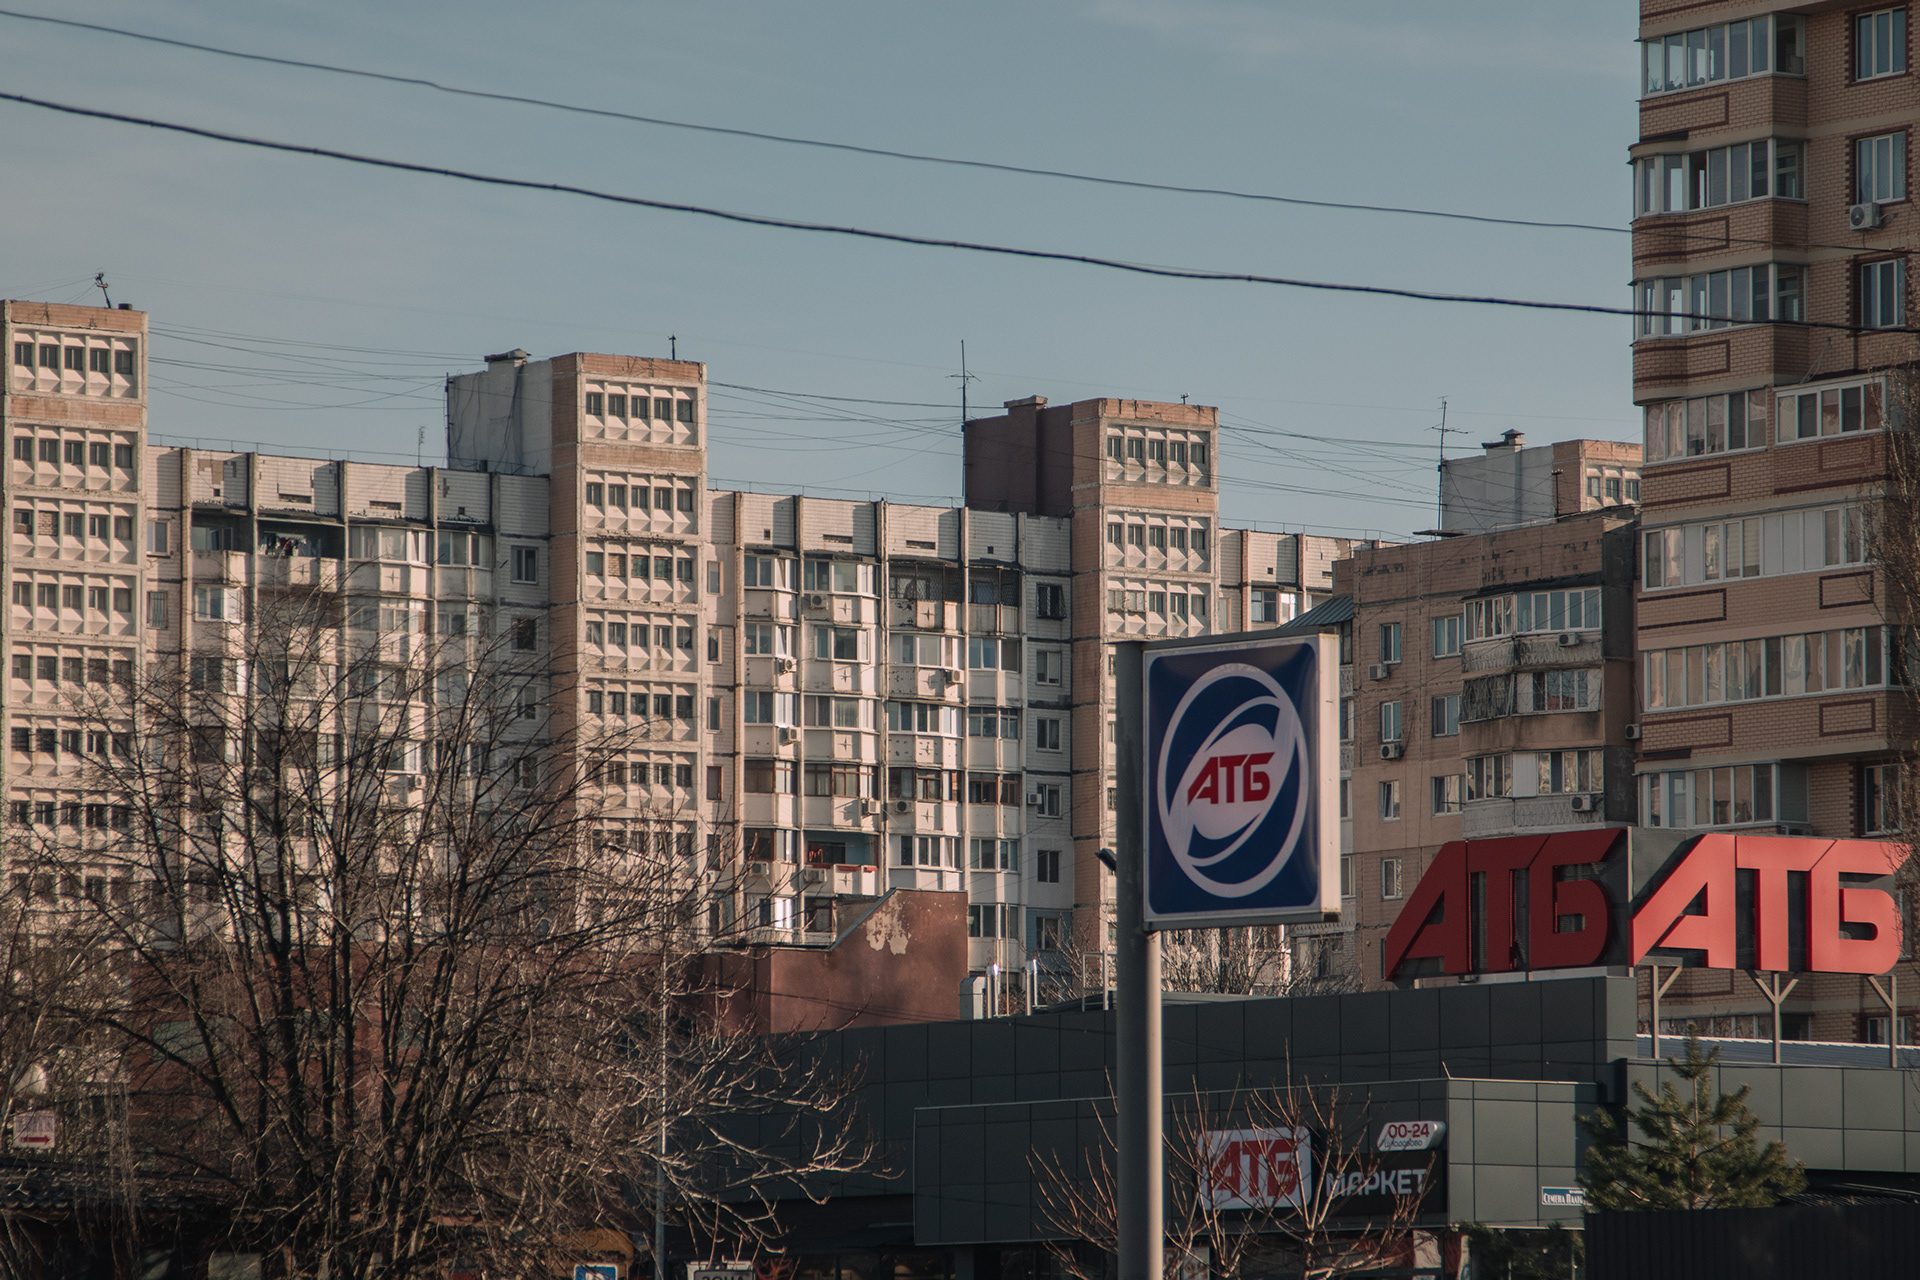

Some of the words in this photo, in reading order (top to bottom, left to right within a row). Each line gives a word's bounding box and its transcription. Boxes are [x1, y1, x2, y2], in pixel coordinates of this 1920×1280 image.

[1188, 752, 1275, 806] АТБ
[1385, 827, 1628, 981] АТБ
[1631, 833, 1914, 975] АТБ
[1388, 1123, 1430, 1138] 00-24
[1207, 1138, 1301, 1198] АТБ
[1326, 1168, 1430, 1197] МАРКЕТ
